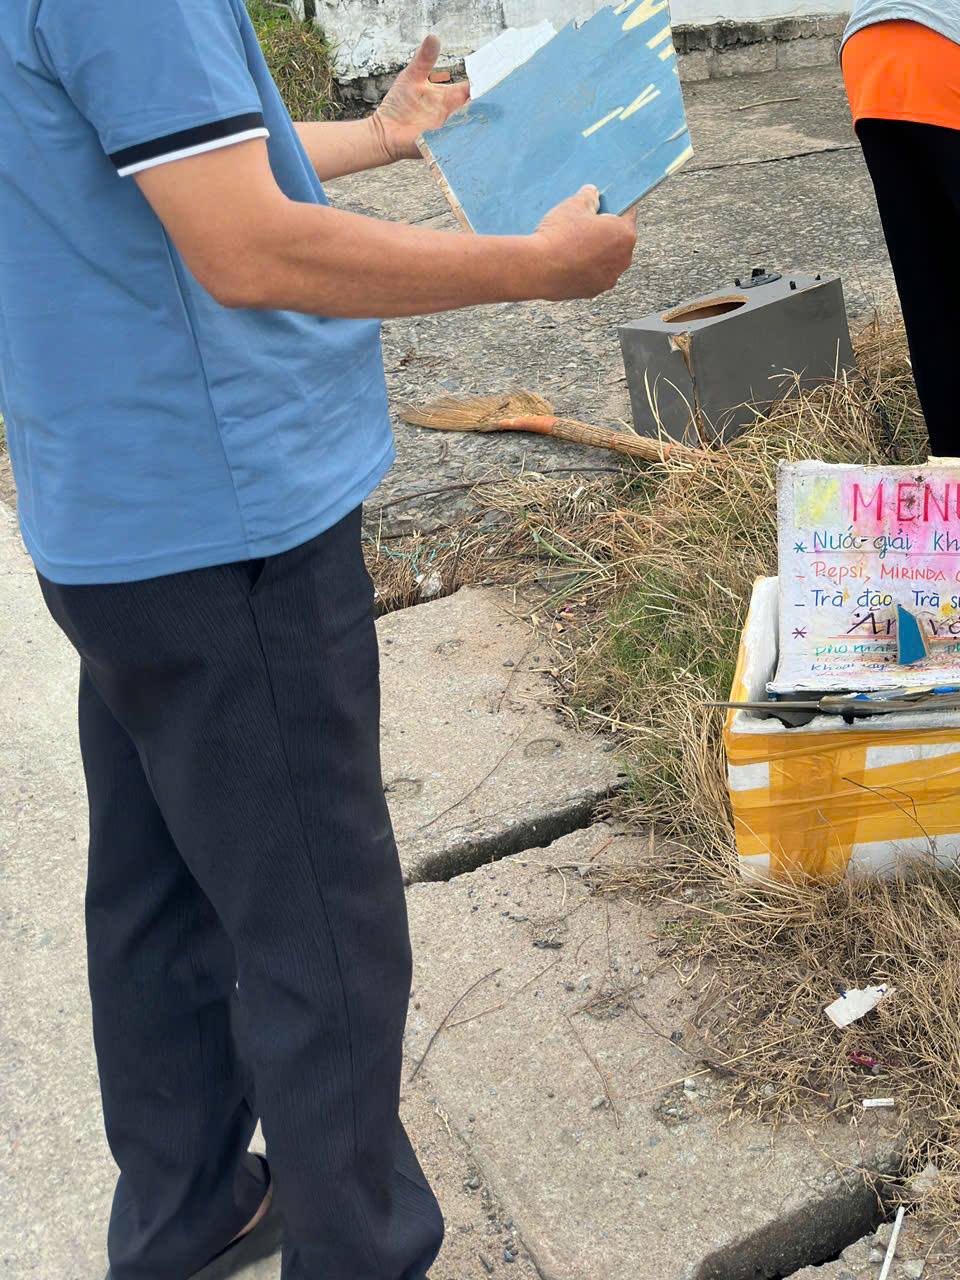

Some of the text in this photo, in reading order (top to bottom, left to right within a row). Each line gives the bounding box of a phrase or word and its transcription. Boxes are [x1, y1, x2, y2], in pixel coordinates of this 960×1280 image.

[872, 528, 911, 559] giải
[811, 588, 844, 608] Trà
[911, 589, 940, 608] Trà
